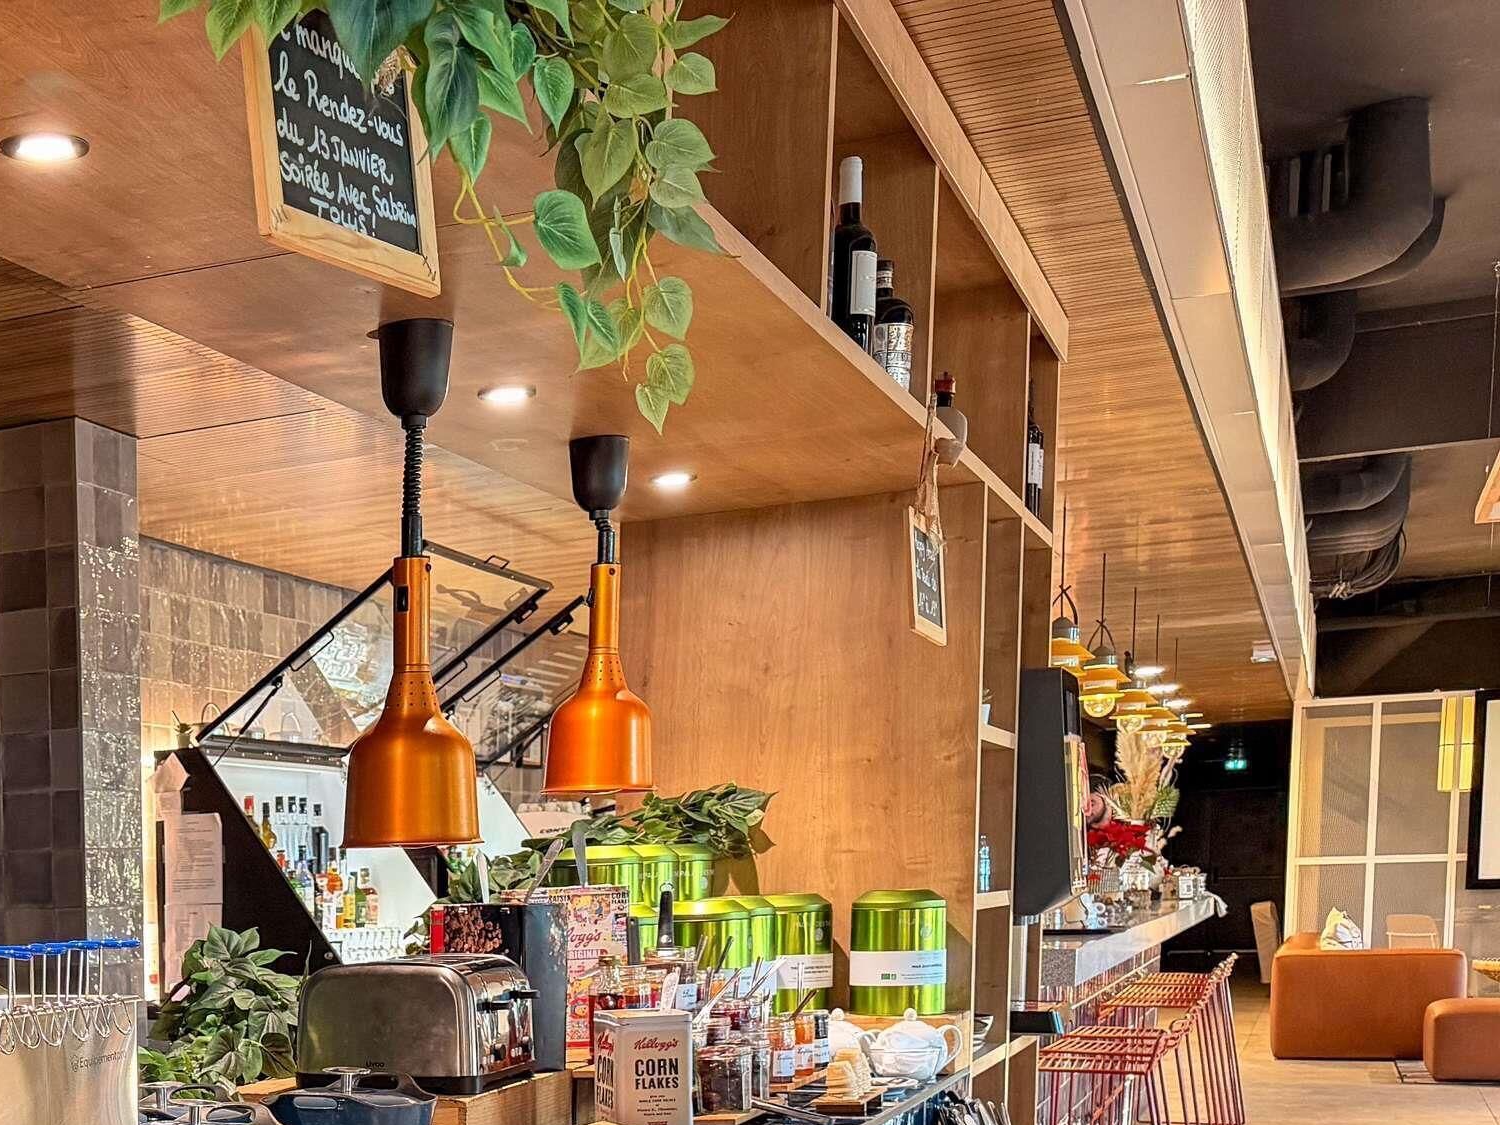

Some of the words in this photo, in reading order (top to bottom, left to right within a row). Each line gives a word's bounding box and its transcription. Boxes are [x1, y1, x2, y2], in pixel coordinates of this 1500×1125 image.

[274, 50, 300, 102] le
[276, 107, 305, 146] du
[307, 125, 330, 160] 13
[634, 1036, 679, 1052] Kellogg's
[634, 1058, 679, 1077] CORN
[635, 1077, 679, 1089] FLAKES
